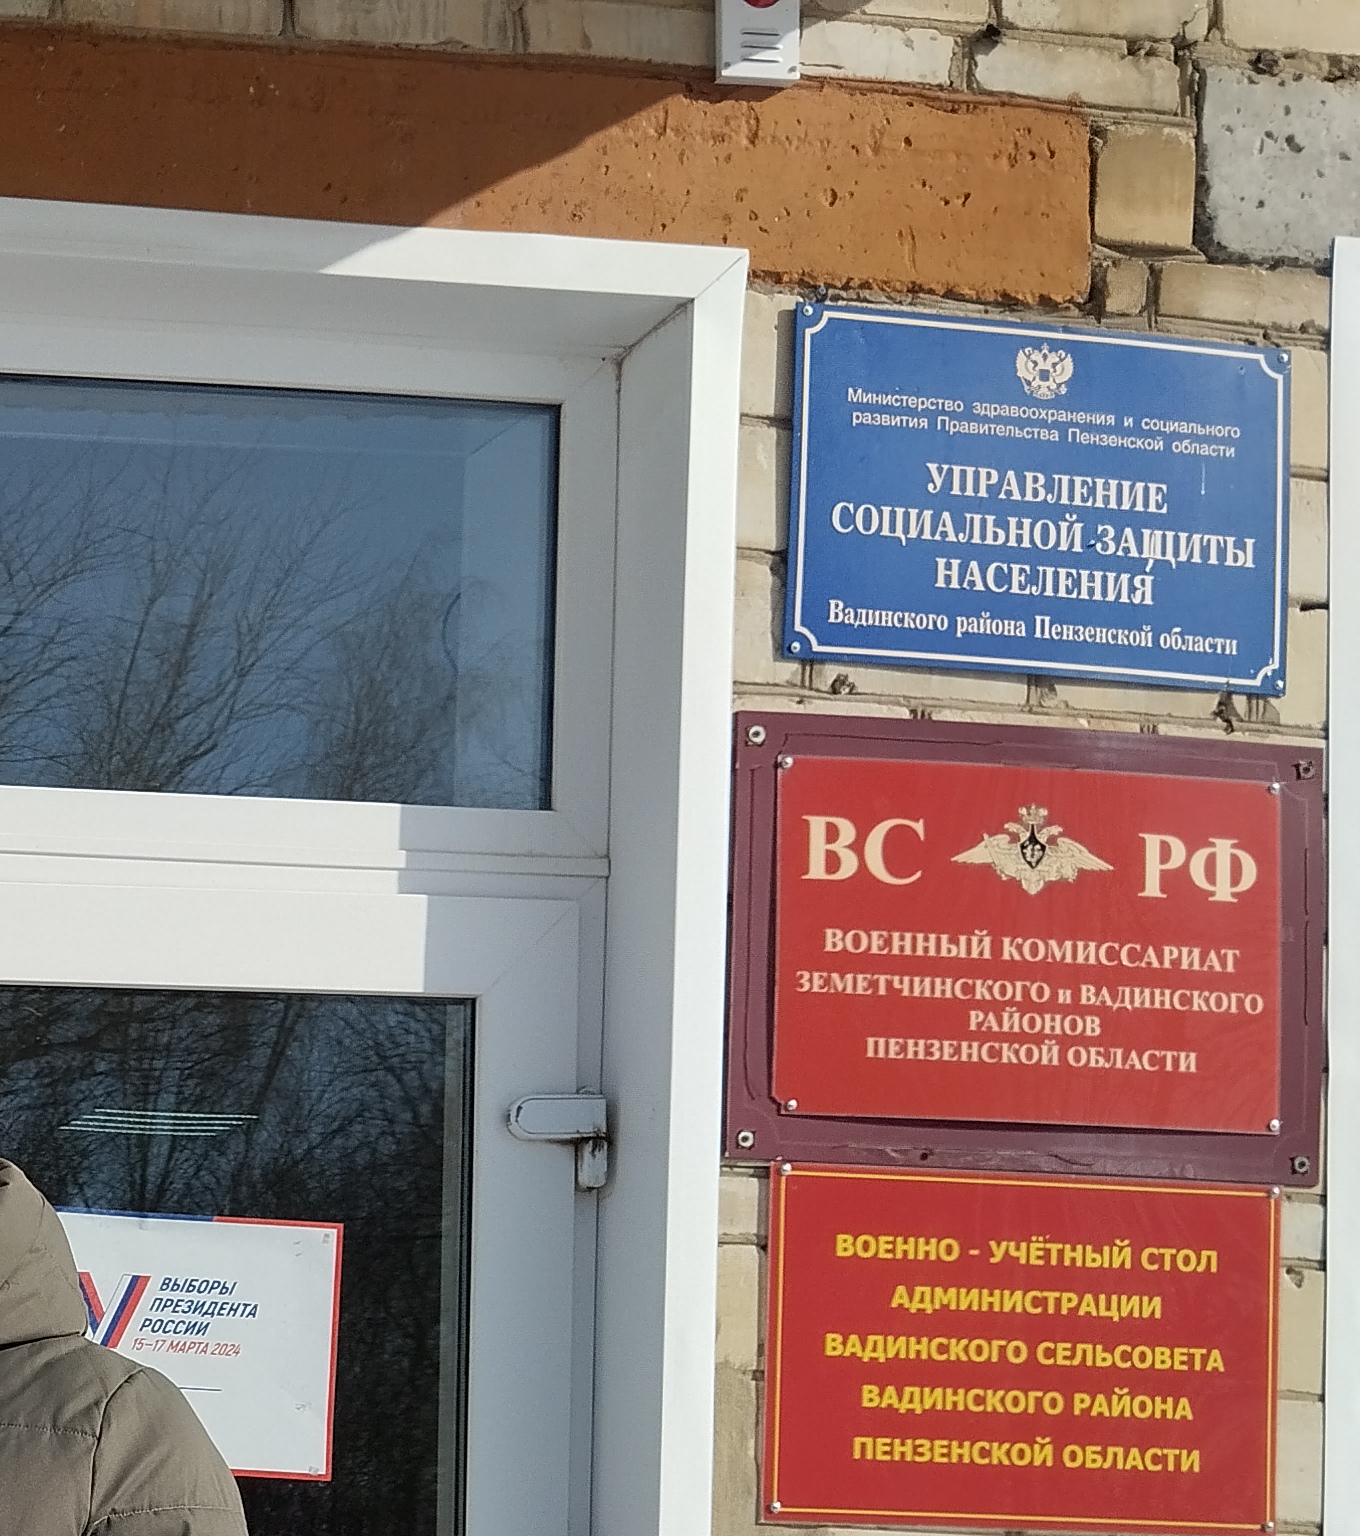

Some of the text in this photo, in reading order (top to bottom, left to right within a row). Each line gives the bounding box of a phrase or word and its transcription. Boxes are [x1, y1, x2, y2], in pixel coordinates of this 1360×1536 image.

[846, 387, 1241, 440] Министерство здравоохранения и социального
[852, 411, 1235, 457] развития Правительства Пензенской области
[925, 462, 1168, 514] УПРАВЛЕНИЕ
[831, 502, 1256, 570] СОЦИАЛЬНОЙ ЗАЩИТЫ
[934, 557, 1156, 606] НАСЕЛЕНИЯ
[827, 599, 1239, 656] Вадинского района Пензенской области
[800, 814, 1258, 903] ВС РФ
[823, 928, 1240, 973] ВОЕННЫЙ КОМИССАРИАТ
[795, 970, 1264, 1016] ЗЕМЕТЧИНСКОГО и ВАДИНСКОГО
[968, 1009, 1101, 1037] РАЙОНОВ
[865, 1036, 1198, 1074] ПЕНЗЕНСКОЙ ОБЛАСТИ
[835, 1233, 960, 1262] ВОЕННО
[989, 1235, 1132, 1270] УЧЁТНЫЙ
[1141, 1247, 1218, 1273] СТОЛ
[158, 1276, 237, 1297] ВЫБОРЫ
[891, 1285, 1163, 1322] АДМИНИСТРАЦИИ
[139, 1318, 211, 1337] РОССИИ
[149, 1297, 259, 1320] ПРЕЗИДЕНТА
[167, 1341, 210, 1355] МАРТА
[211, 1342, 242, 1357] 2024
[824, 1333, 1225, 1373] ВАДИНСКОГО СЕЛЬСОВЕТА
[861, 1385, 1193, 1421] ВАДИНСКОГО РАЙОНА
[853, 1437, 1201, 1473] ПЕНЗЕНСКОЙ ОБЛАСТИ
